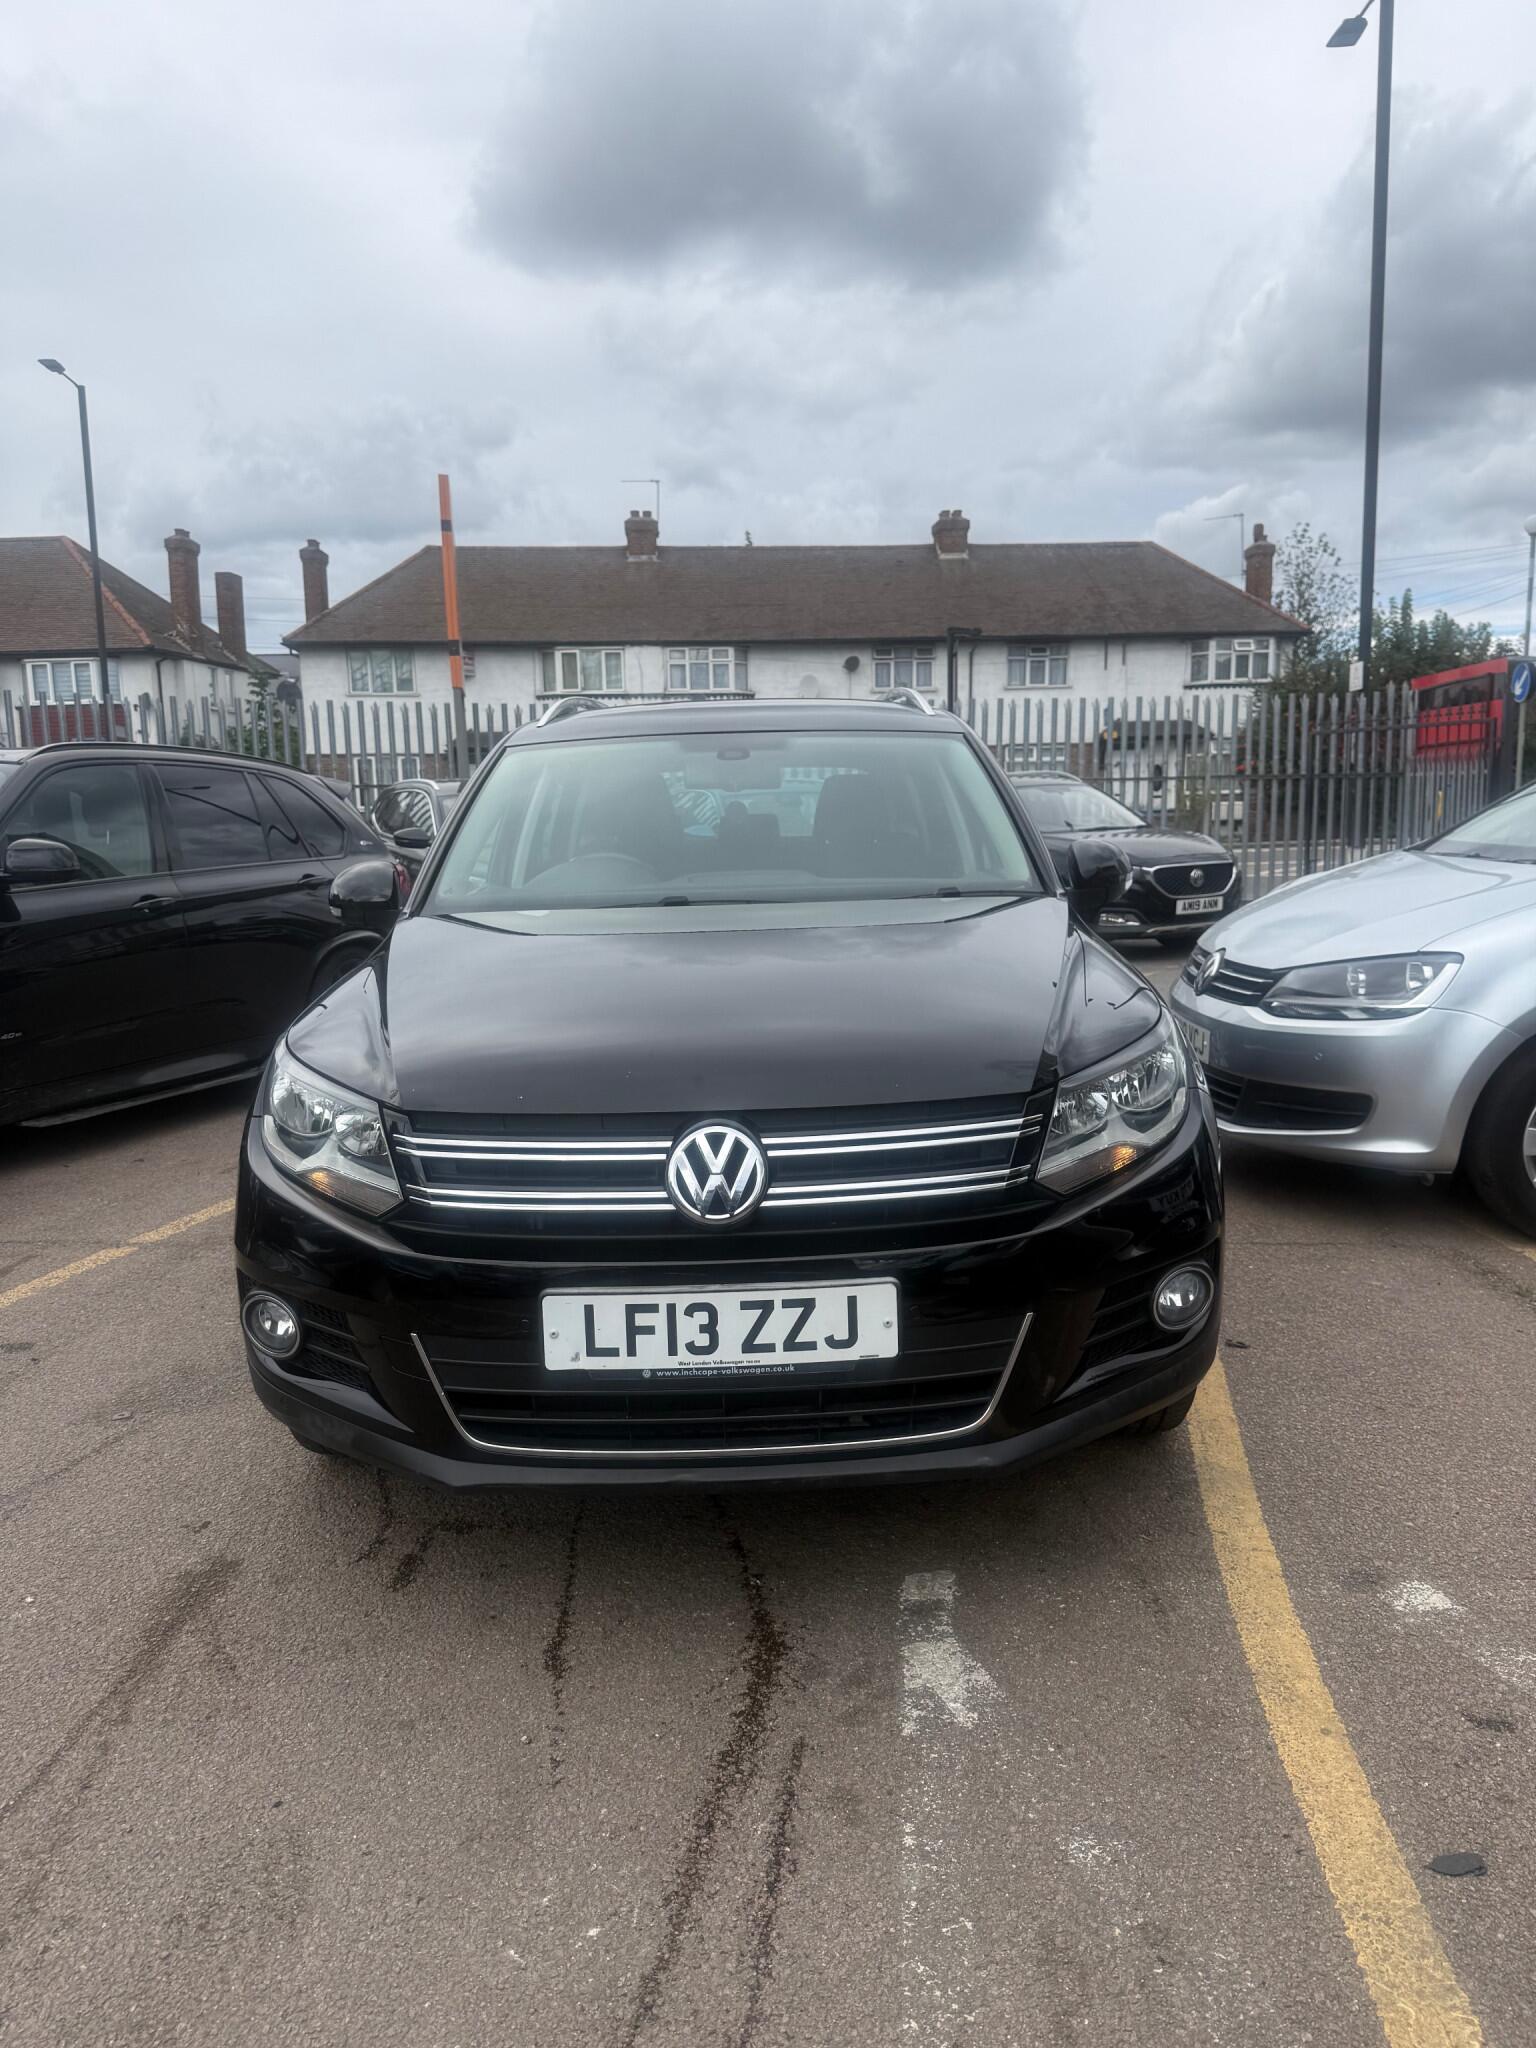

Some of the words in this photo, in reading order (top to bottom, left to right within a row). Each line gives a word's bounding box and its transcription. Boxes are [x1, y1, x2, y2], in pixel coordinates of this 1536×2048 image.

[1182, 900, 1201, 912] AM19
[584, 1302, 720, 1358] LF13
[739, 1295, 859, 1354] ZZJ
[656, 1364, 796, 1377] www.inchcape-volkswagen.co.uk
